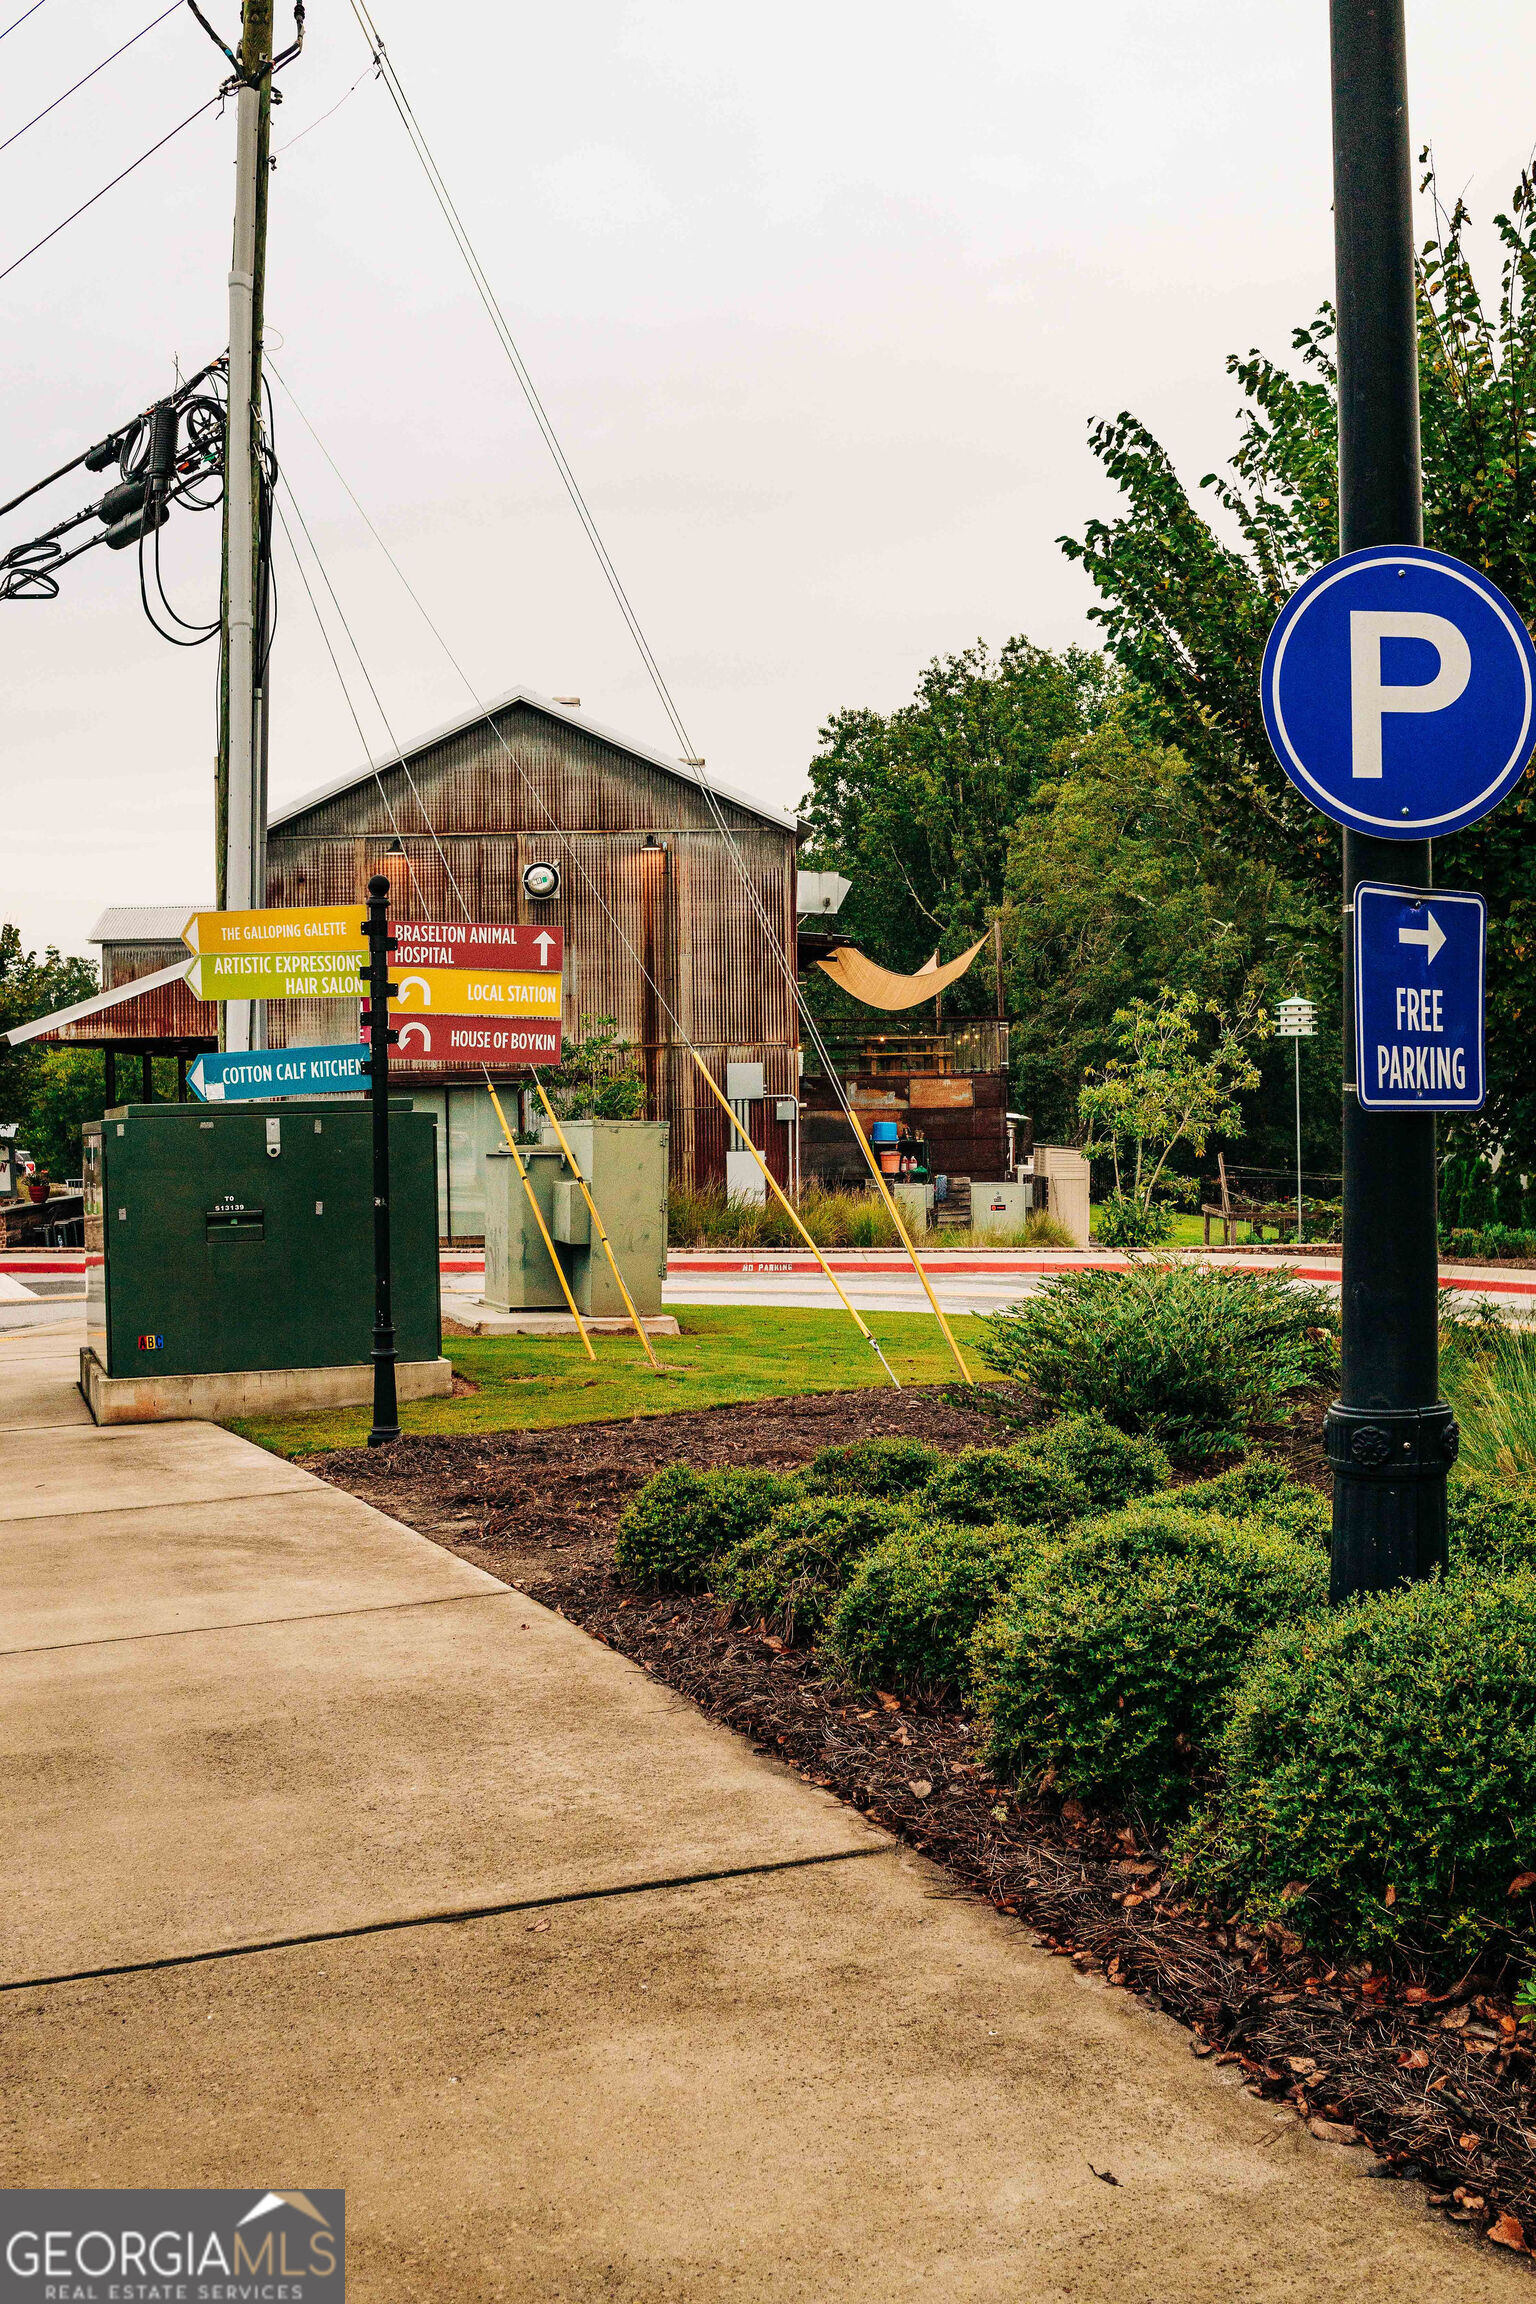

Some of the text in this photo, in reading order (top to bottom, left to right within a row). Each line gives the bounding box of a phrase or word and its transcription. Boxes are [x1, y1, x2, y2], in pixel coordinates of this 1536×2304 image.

[1349, 609, 1472, 779] P
[221, 921, 347, 941] THE GALLOPING GALETTE
[395, 924, 517, 945] BRASELTON ANIMAL
[214, 954, 363, 975] ARTISTIC EXPRESSIONS
[394, 946, 455, 964] HOSPITAL
[286, 976, 364, 995] HAIR SALON
[467, 983, 556, 1003] LOCAL STATION
[1396, 987, 1444, 1032] FREE
[451, 1030, 556, 1051] HOUSE OF BOYKIN
[222, 1064, 273, 1085] COTTON
[276, 1062, 307, 1081] CALF
[1377, 1045, 1466, 1090] PARKING
[758, 1263, 793, 1272] PARKING
[139, 1335, 163, 1349] ABC
